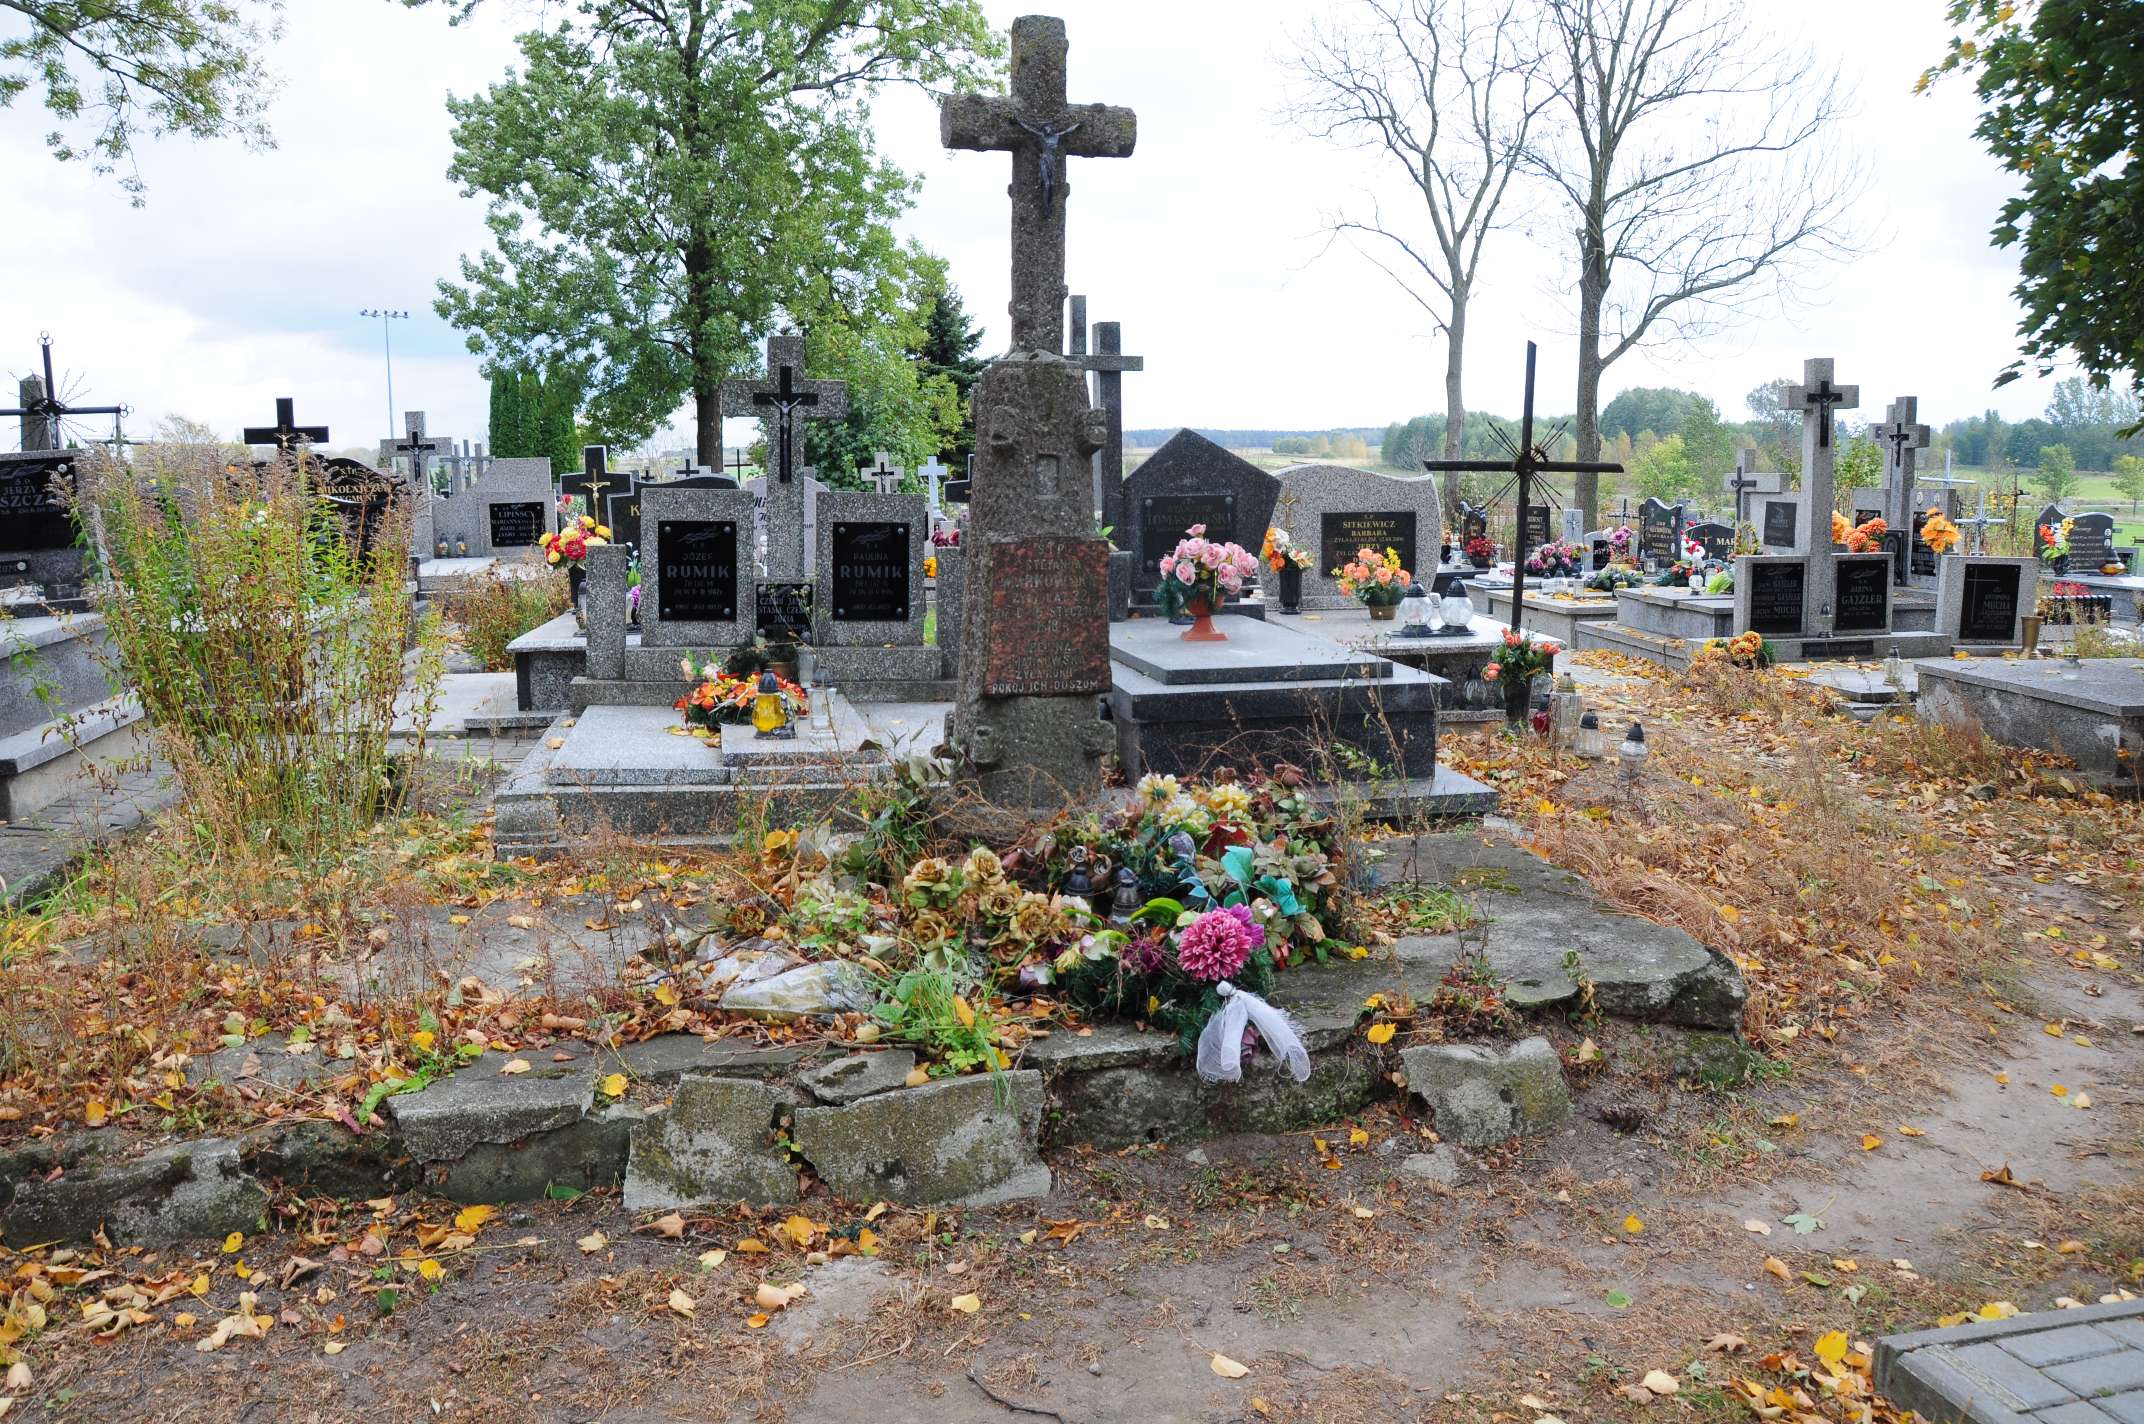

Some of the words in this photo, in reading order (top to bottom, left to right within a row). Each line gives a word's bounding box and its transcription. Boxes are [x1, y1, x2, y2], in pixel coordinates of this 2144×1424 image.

[630, 504, 641, 517] K
[1342, 520, 1396, 529] SITKIEWICZ
[666, 564, 729, 578] RUMIK
[840, 564, 903, 578] RUMIK
[1029, 680, 1048, 693] ICH
